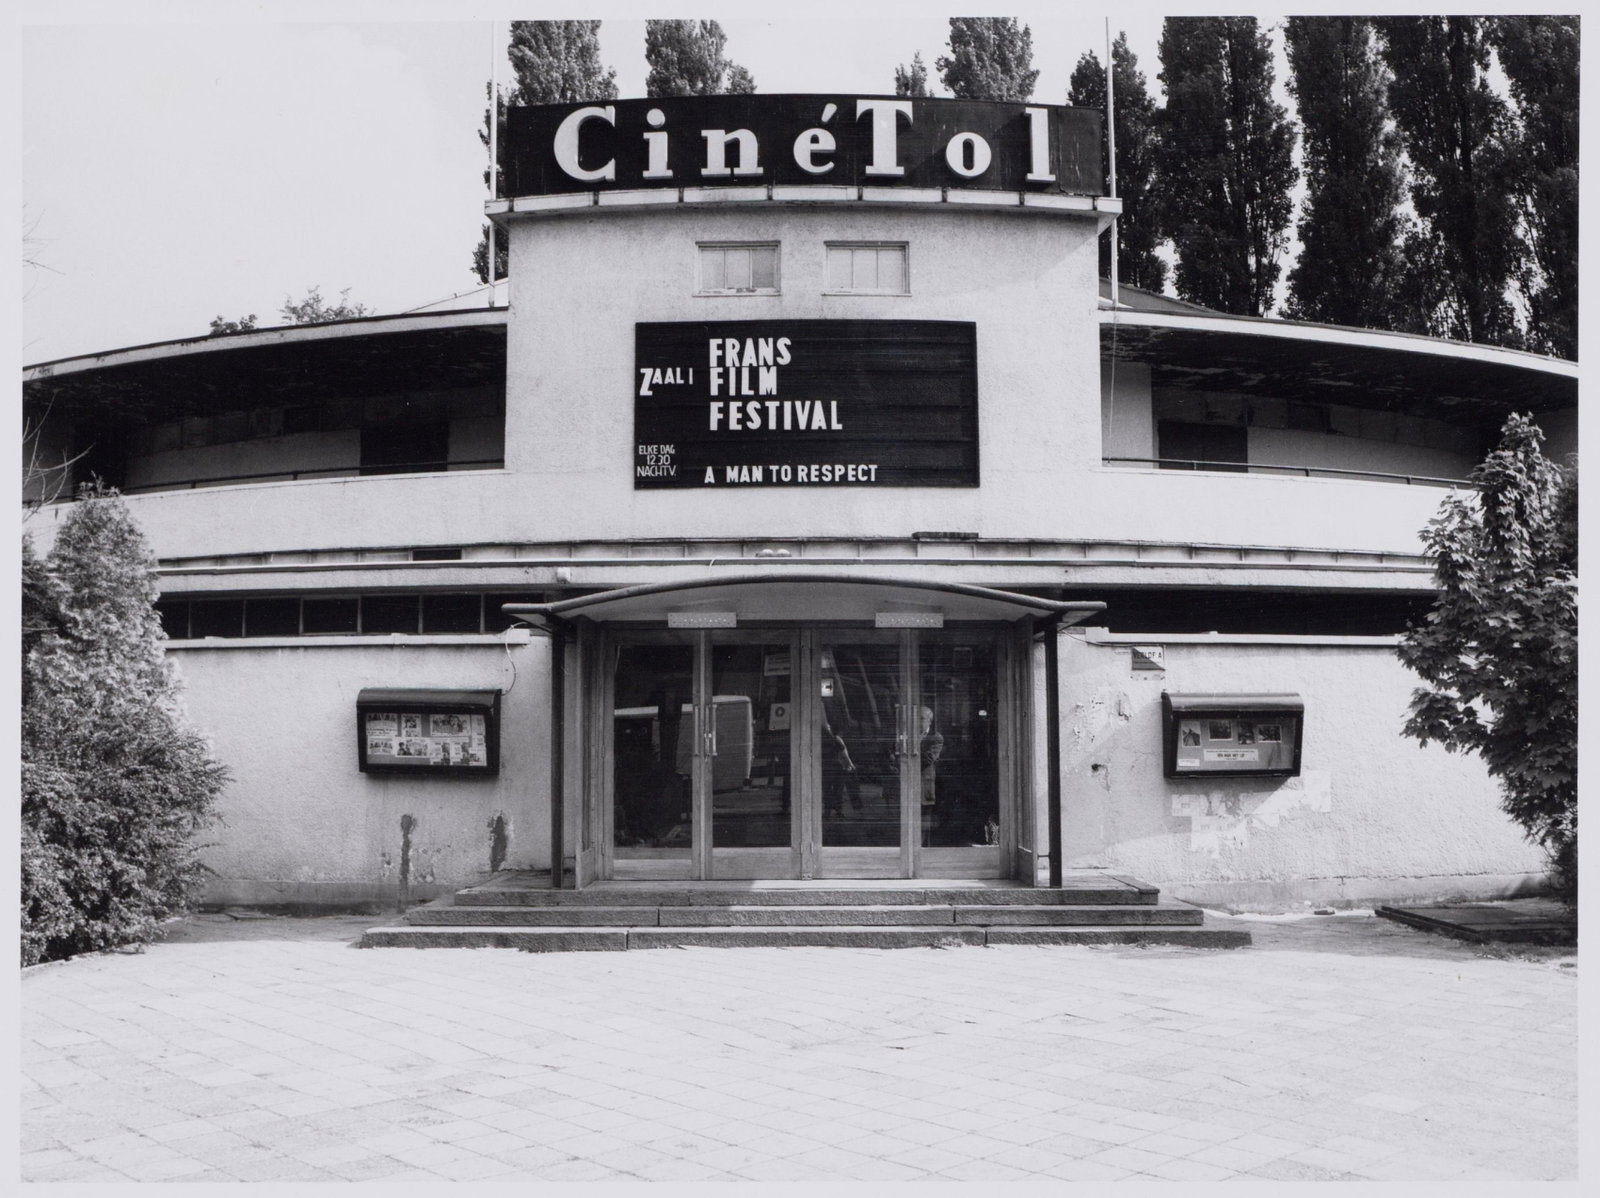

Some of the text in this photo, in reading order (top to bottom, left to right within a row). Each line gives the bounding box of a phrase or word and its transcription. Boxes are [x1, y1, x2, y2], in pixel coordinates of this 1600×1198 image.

[709, 337, 792, 367] FRANS
[639, 367, 685, 396] ZAAL
[709, 366, 777, 396] FILM
[709, 400, 843, 431] FESTIVAL
[638, 444, 676, 455] ELKE DAG
[704, 464, 878, 484] A MAN TO RESPECT
